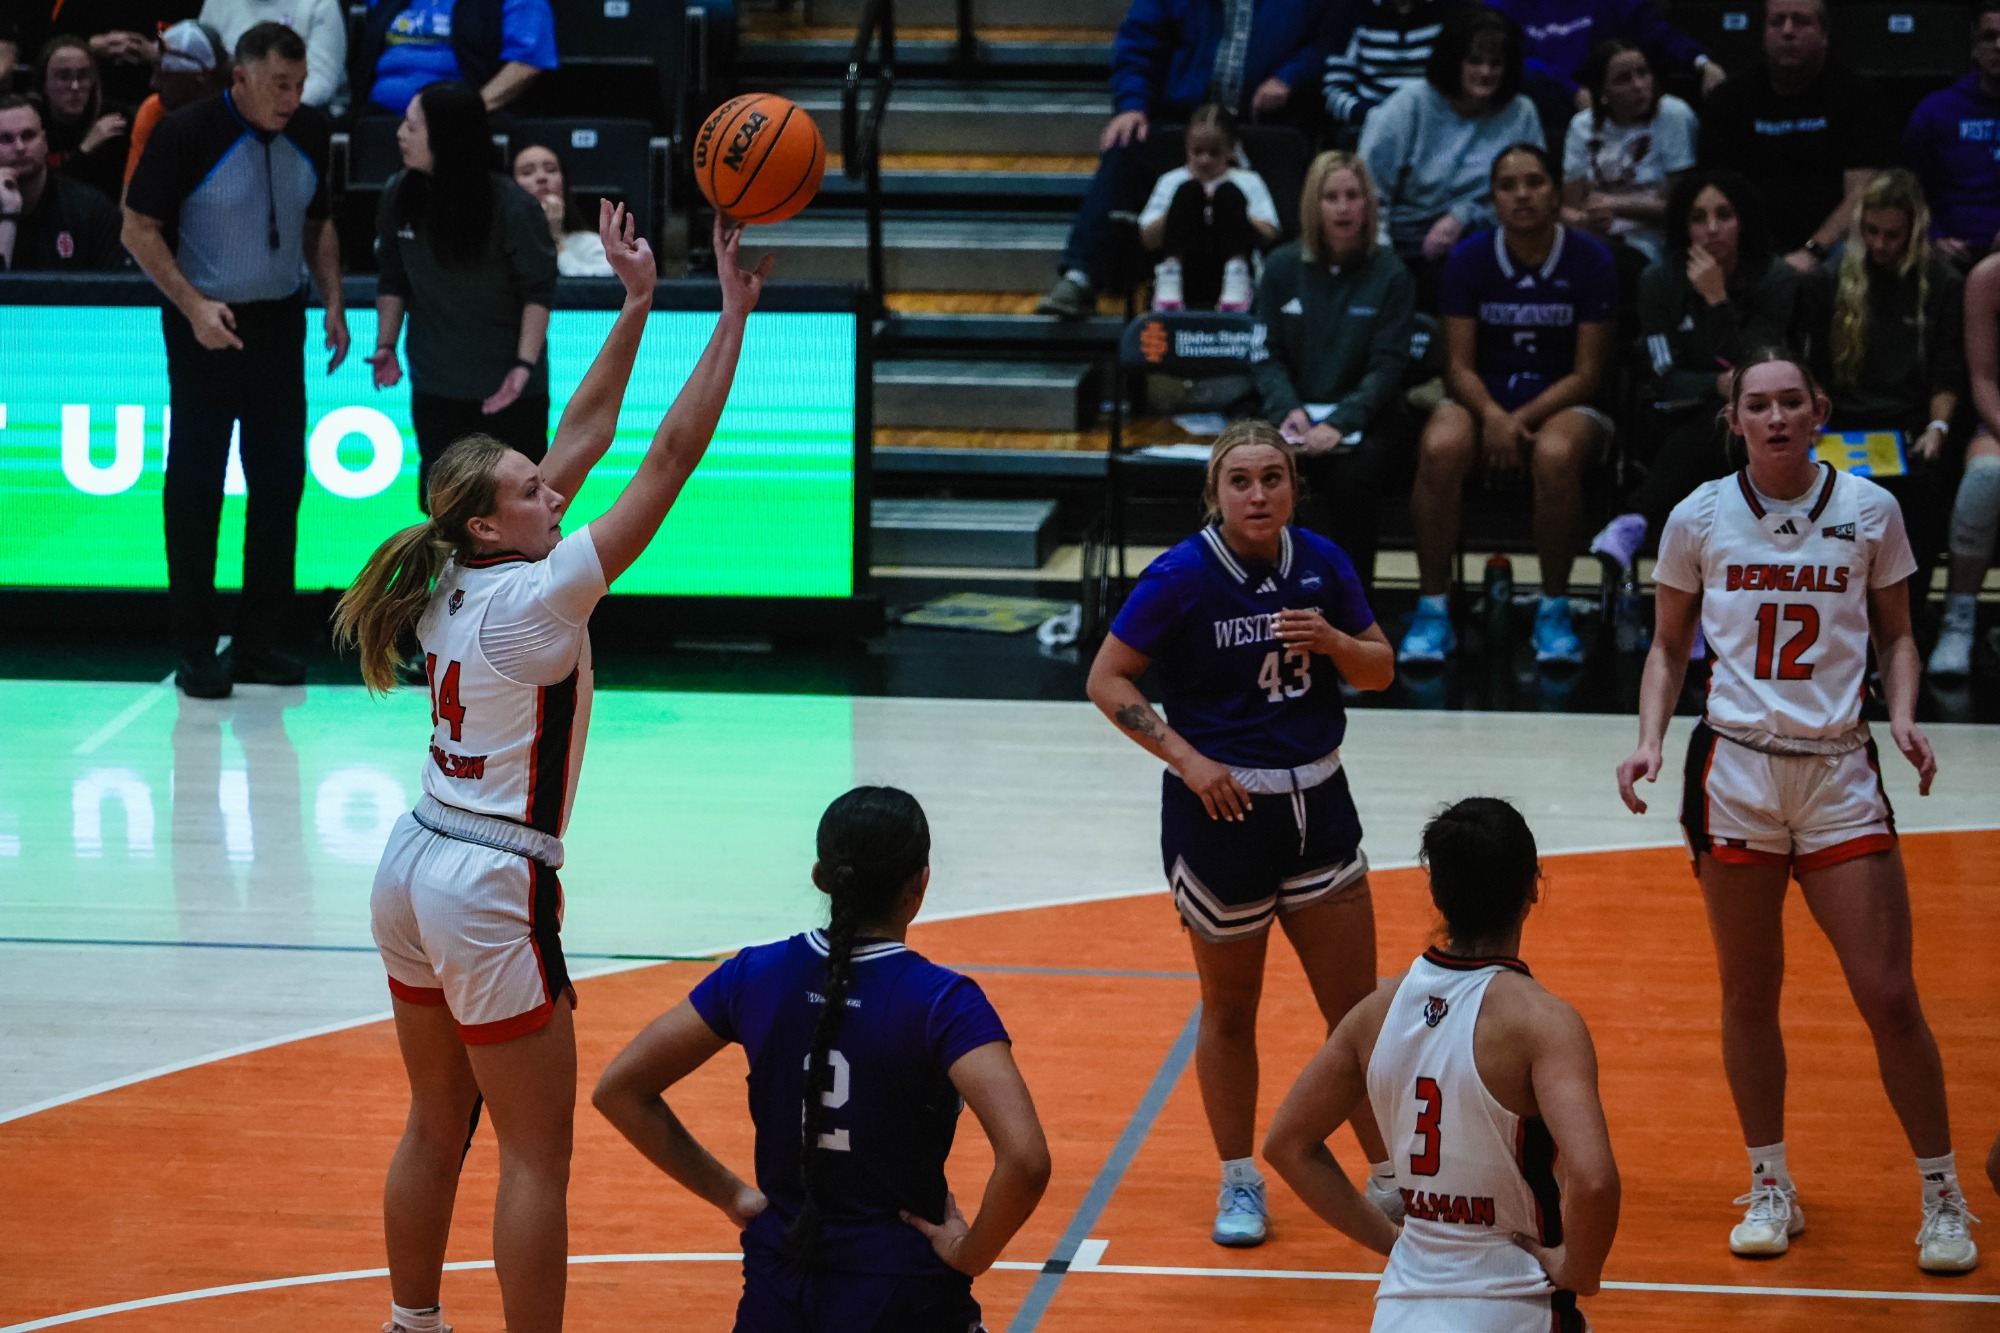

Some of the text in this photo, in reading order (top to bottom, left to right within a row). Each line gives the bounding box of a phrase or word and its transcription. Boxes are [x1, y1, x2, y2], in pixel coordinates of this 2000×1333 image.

[723, 111, 770, 172] NCAA
[1726, 564, 1849, 593] BENGALS
[1755, 603, 1820, 680] 12
[1257, 650, 1312, 703] 43
[1410, 1077, 1442, 1176] 3
